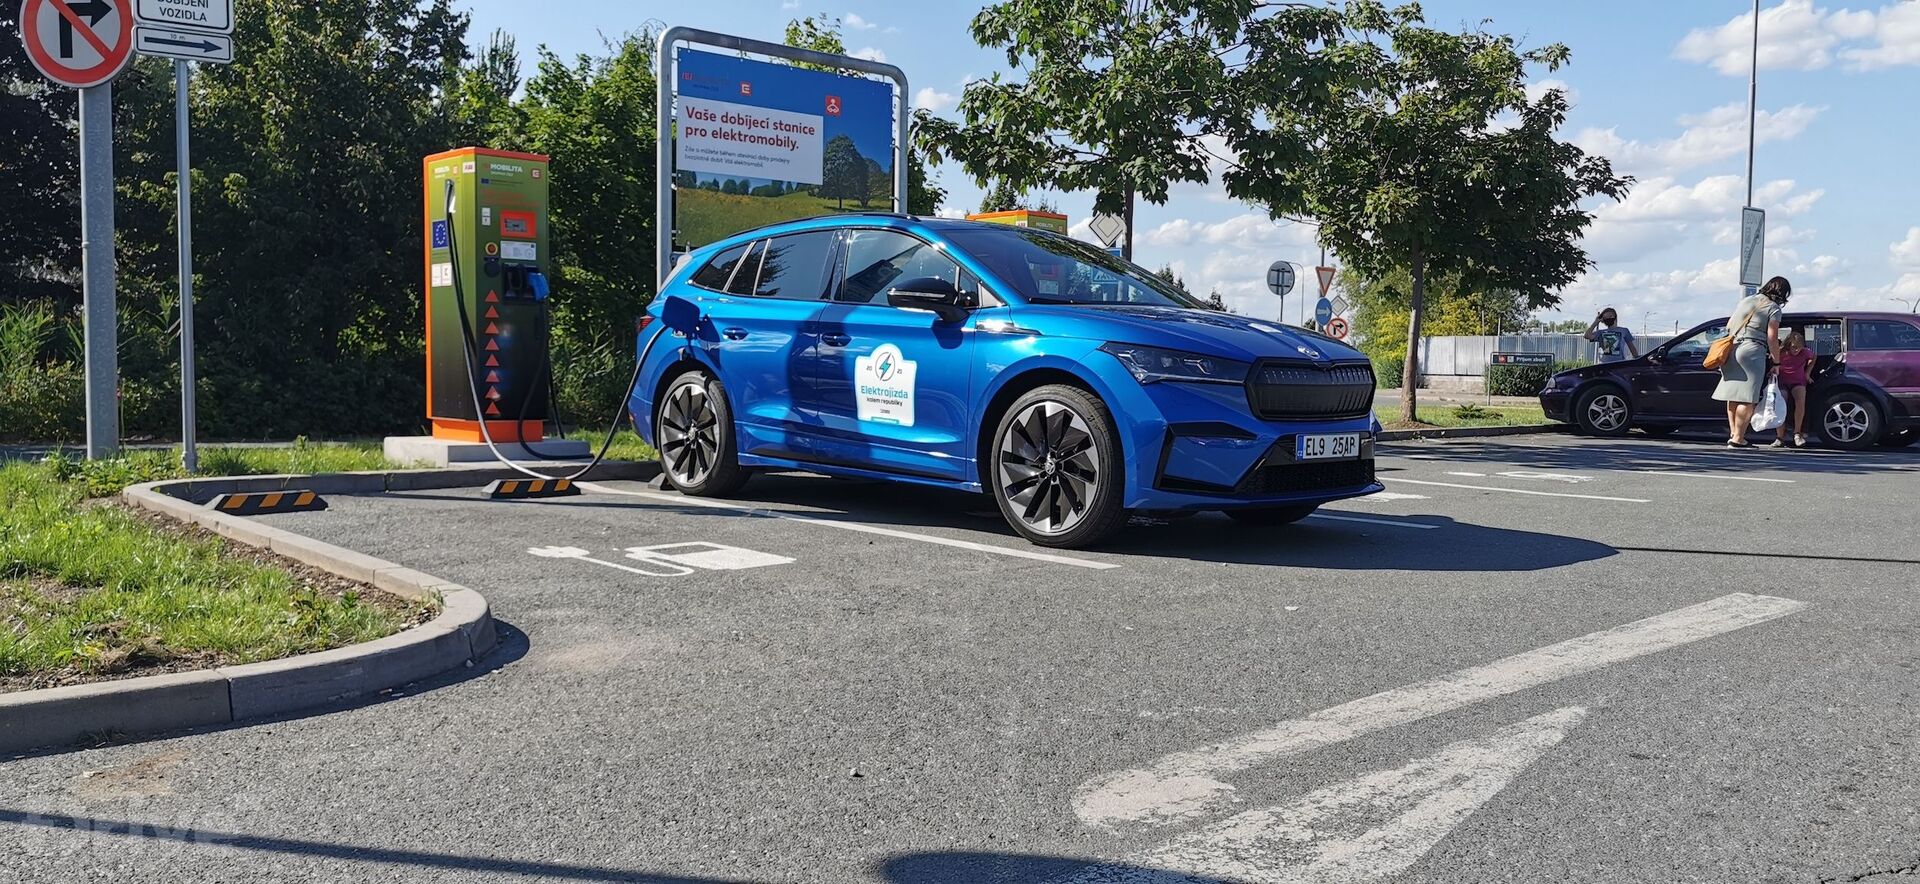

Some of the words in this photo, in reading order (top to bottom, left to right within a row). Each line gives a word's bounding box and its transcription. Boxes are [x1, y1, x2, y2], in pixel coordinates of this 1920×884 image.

[159, 6, 207, 21] VOZIDLA
[685, 105, 717, 122] Vaše
[720, 111, 770, 130] dobíjecí
[772, 120, 815, 136] stanice
[685, 126, 707, 138] pro
[711, 127, 799, 151] elektromobily.
[490, 164, 523, 173] MOBILITA
[881, 398, 903, 407] republiky
[1305, 437, 1325, 456] EL9
